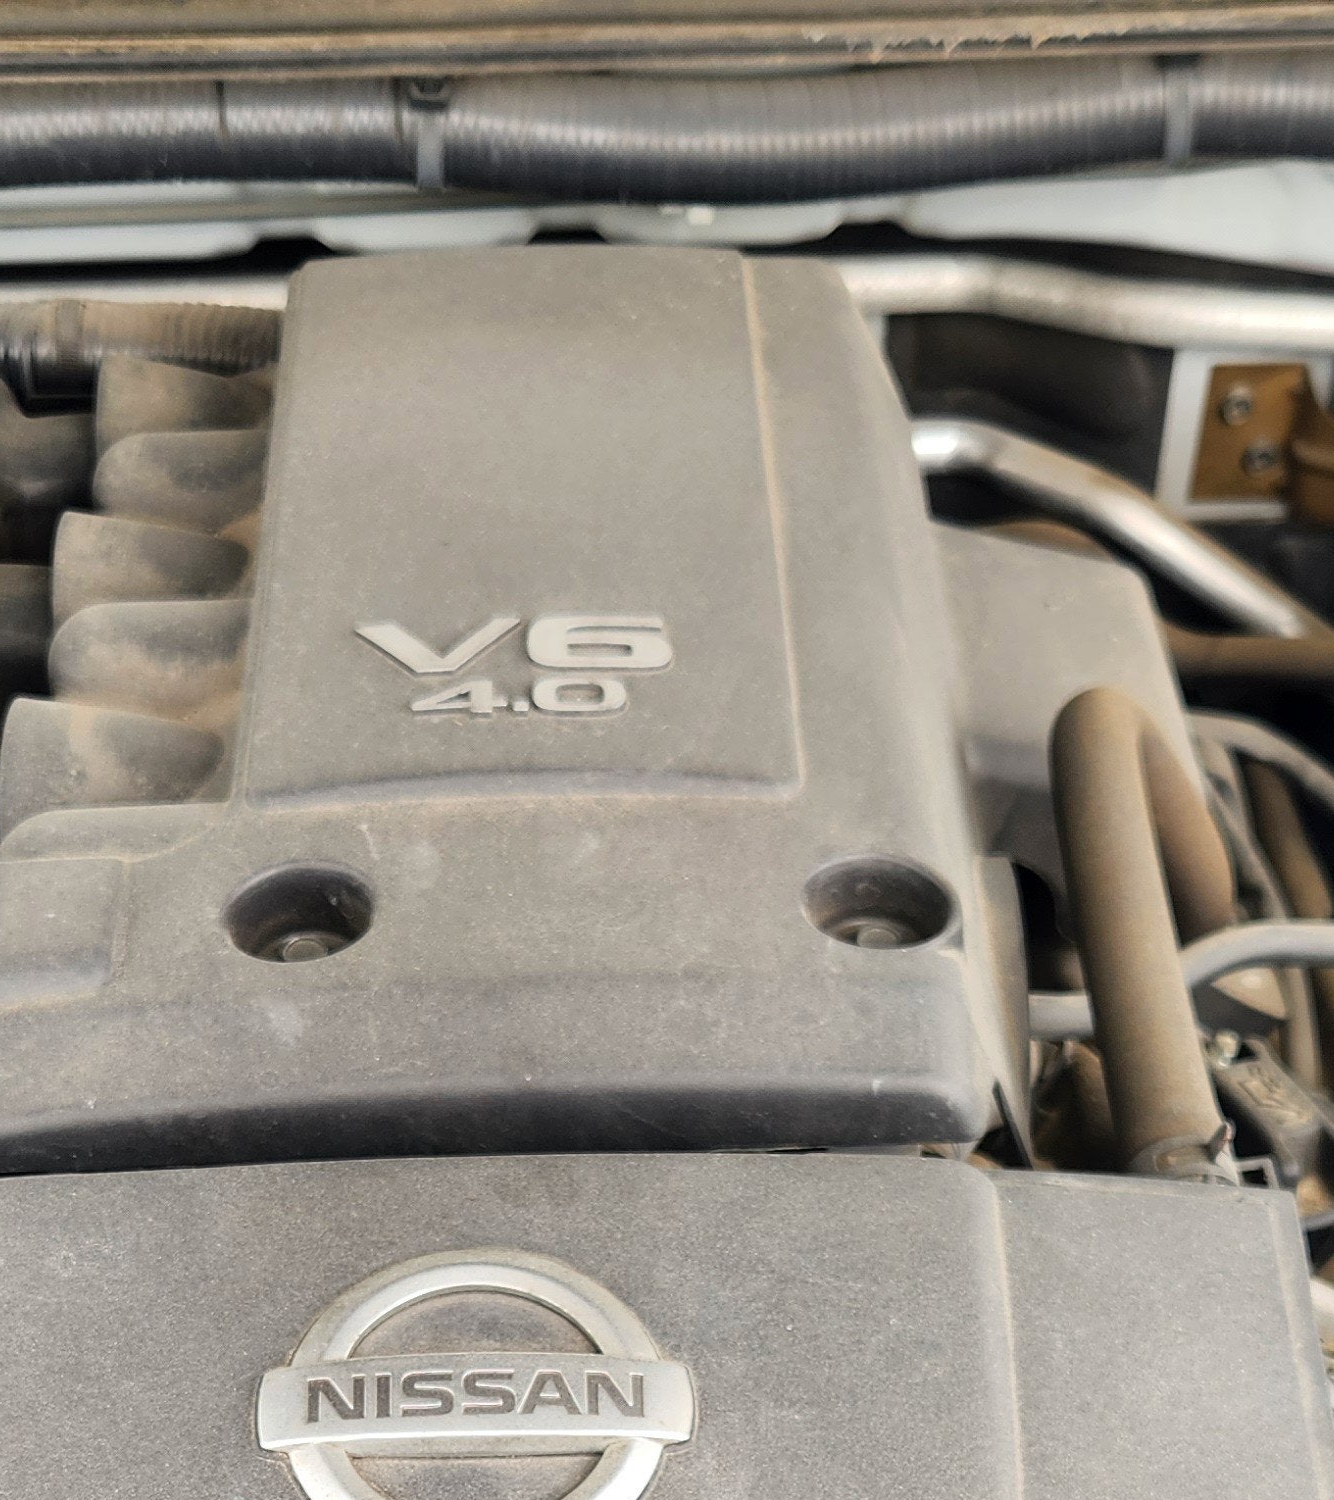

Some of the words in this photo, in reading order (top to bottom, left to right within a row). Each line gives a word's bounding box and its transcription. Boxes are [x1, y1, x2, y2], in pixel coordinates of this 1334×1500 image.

[355, 615, 672, 674] V6
[411, 677, 628, 714] 4.0
[305, 1369, 645, 1424] NISSAN
